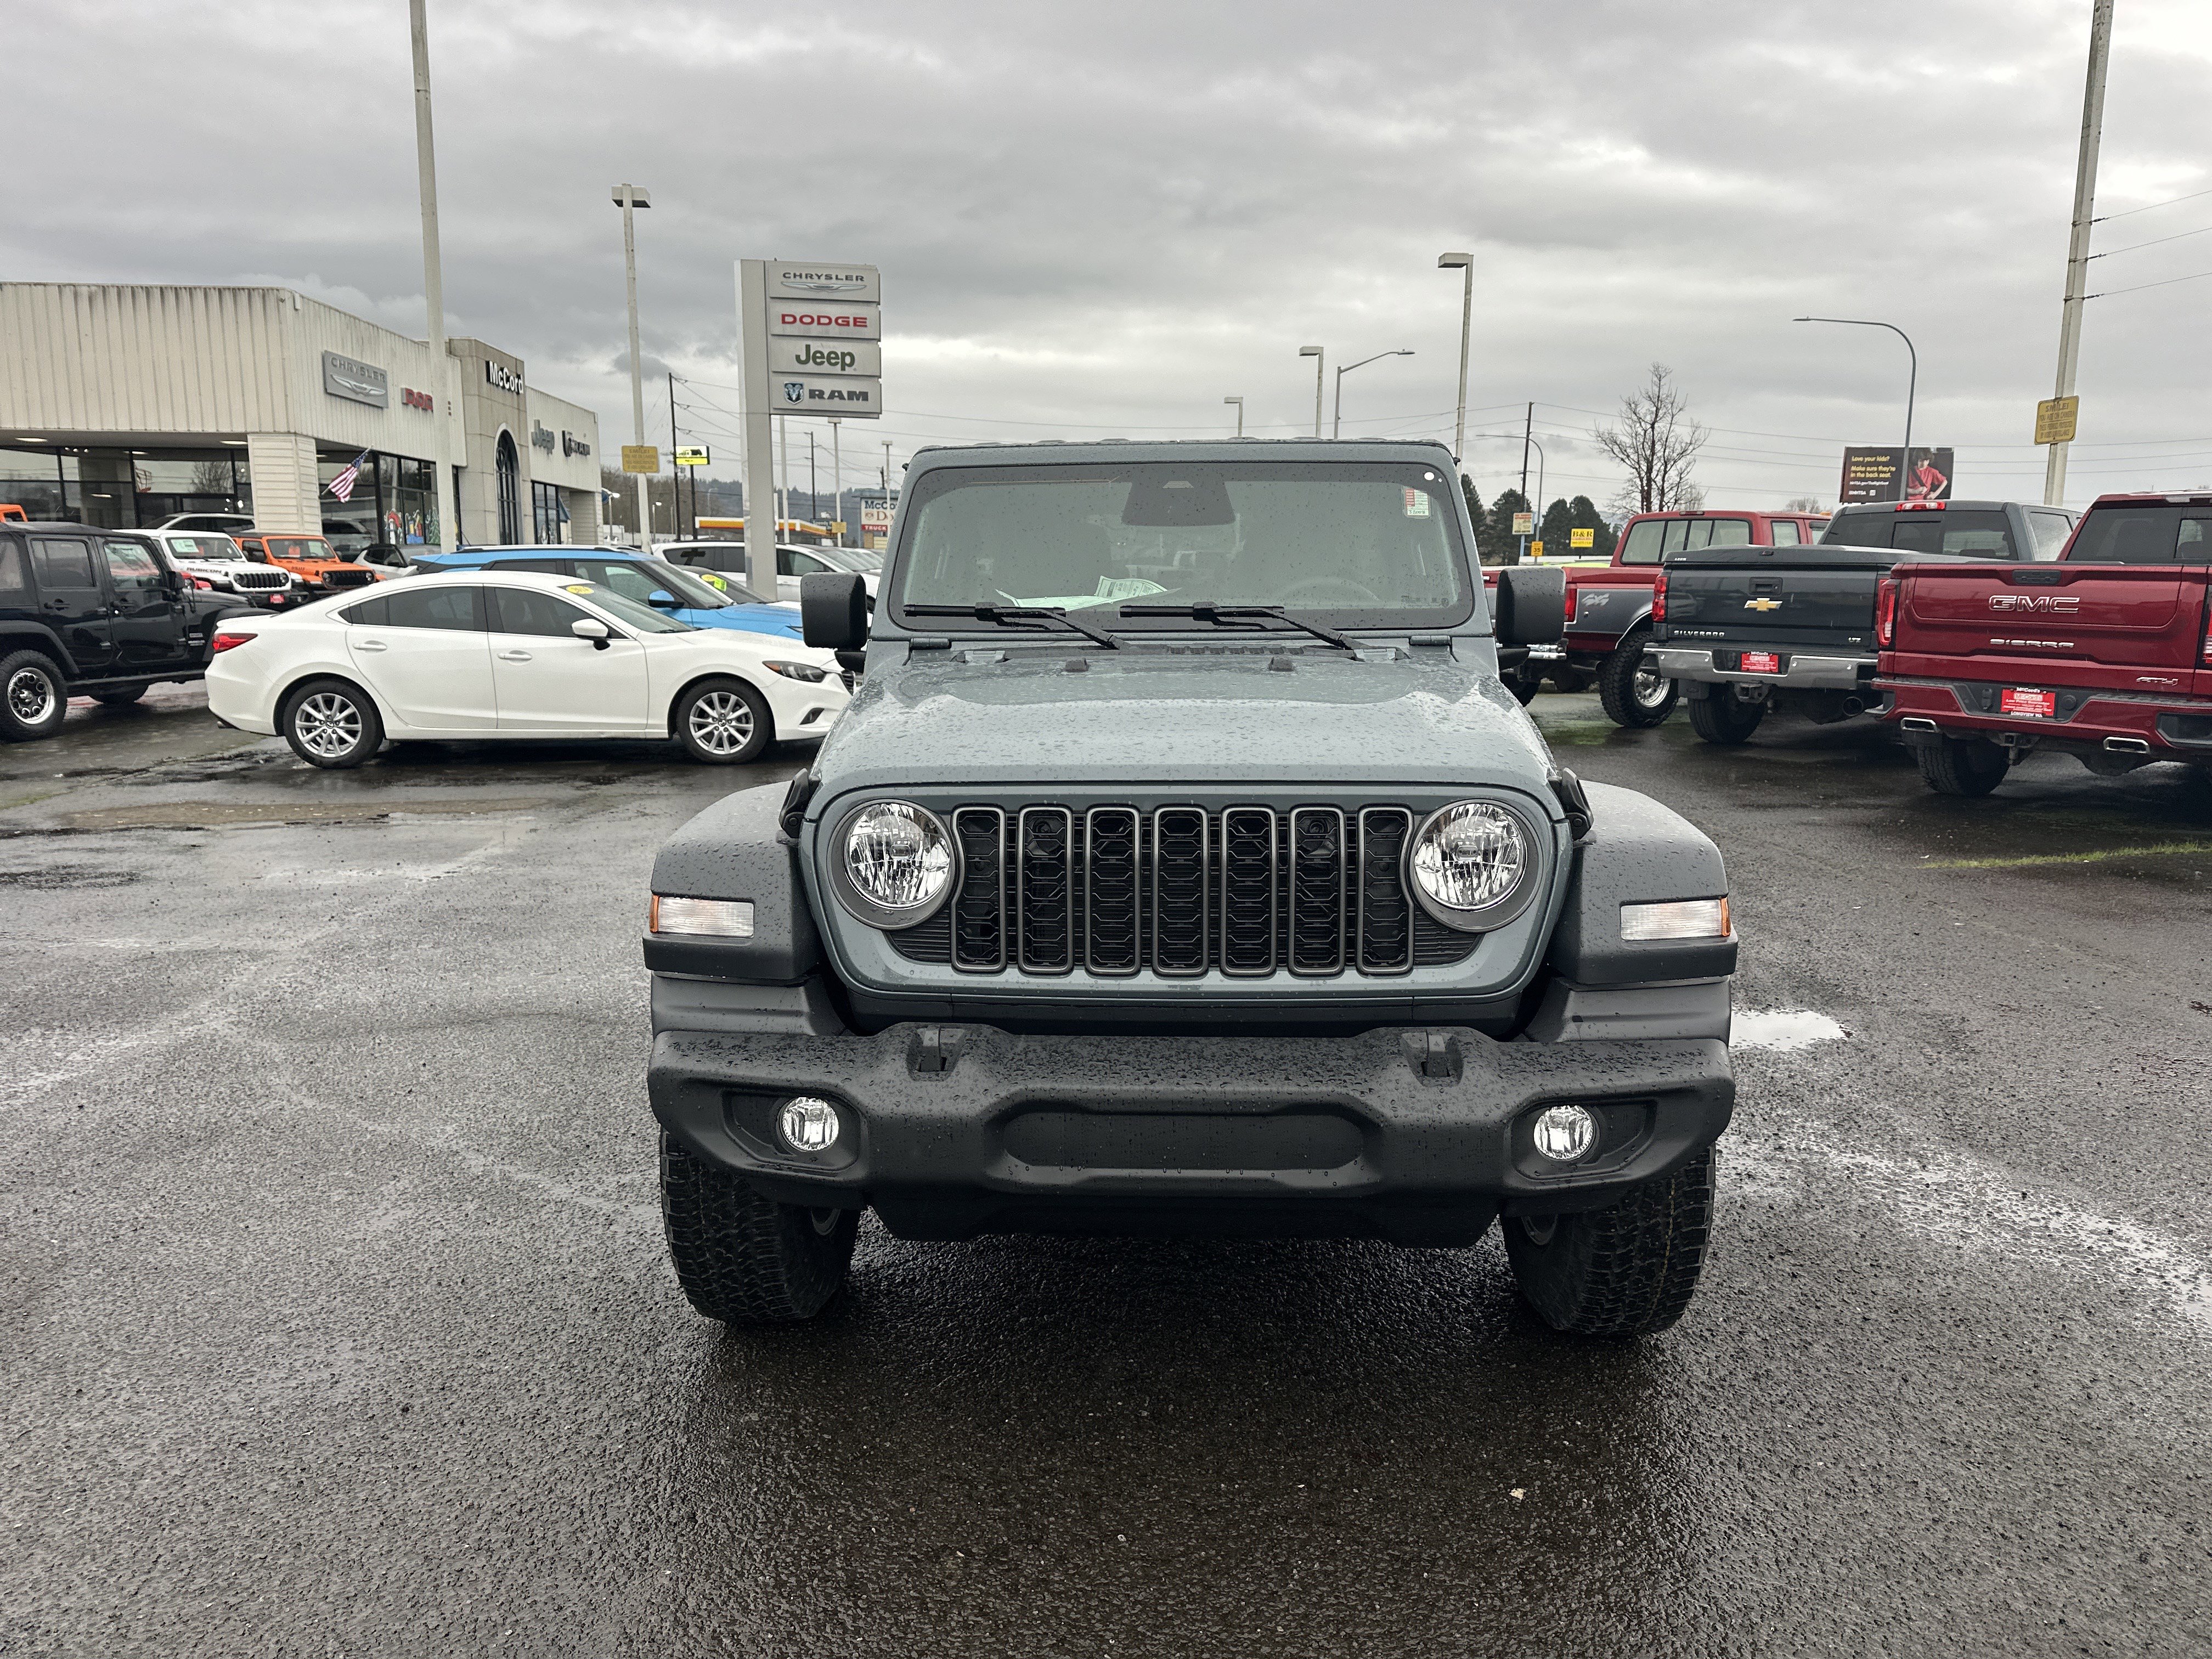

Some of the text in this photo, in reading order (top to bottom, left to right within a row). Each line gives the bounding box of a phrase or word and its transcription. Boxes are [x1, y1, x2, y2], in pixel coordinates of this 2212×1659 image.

[782, 272, 865, 281] CHRYSLER
[781, 314, 868, 328] DODGE
[795, 344, 856, 371] Jeep
[330, 357, 387, 382] CHRYSLER
[488, 360, 523, 394] McCord
[404, 388, 433, 411] DOD
[809, 389, 868, 401] RAM
[2045, 402, 2069, 412] SMILE!
[531, 419, 555, 455] Jeep
[865, 500, 897, 510] McCo
[1989, 595, 2080, 613] GMC
[1990, 639, 2074, 648] SIERRA
[2136, 676, 2179, 686] AT4
